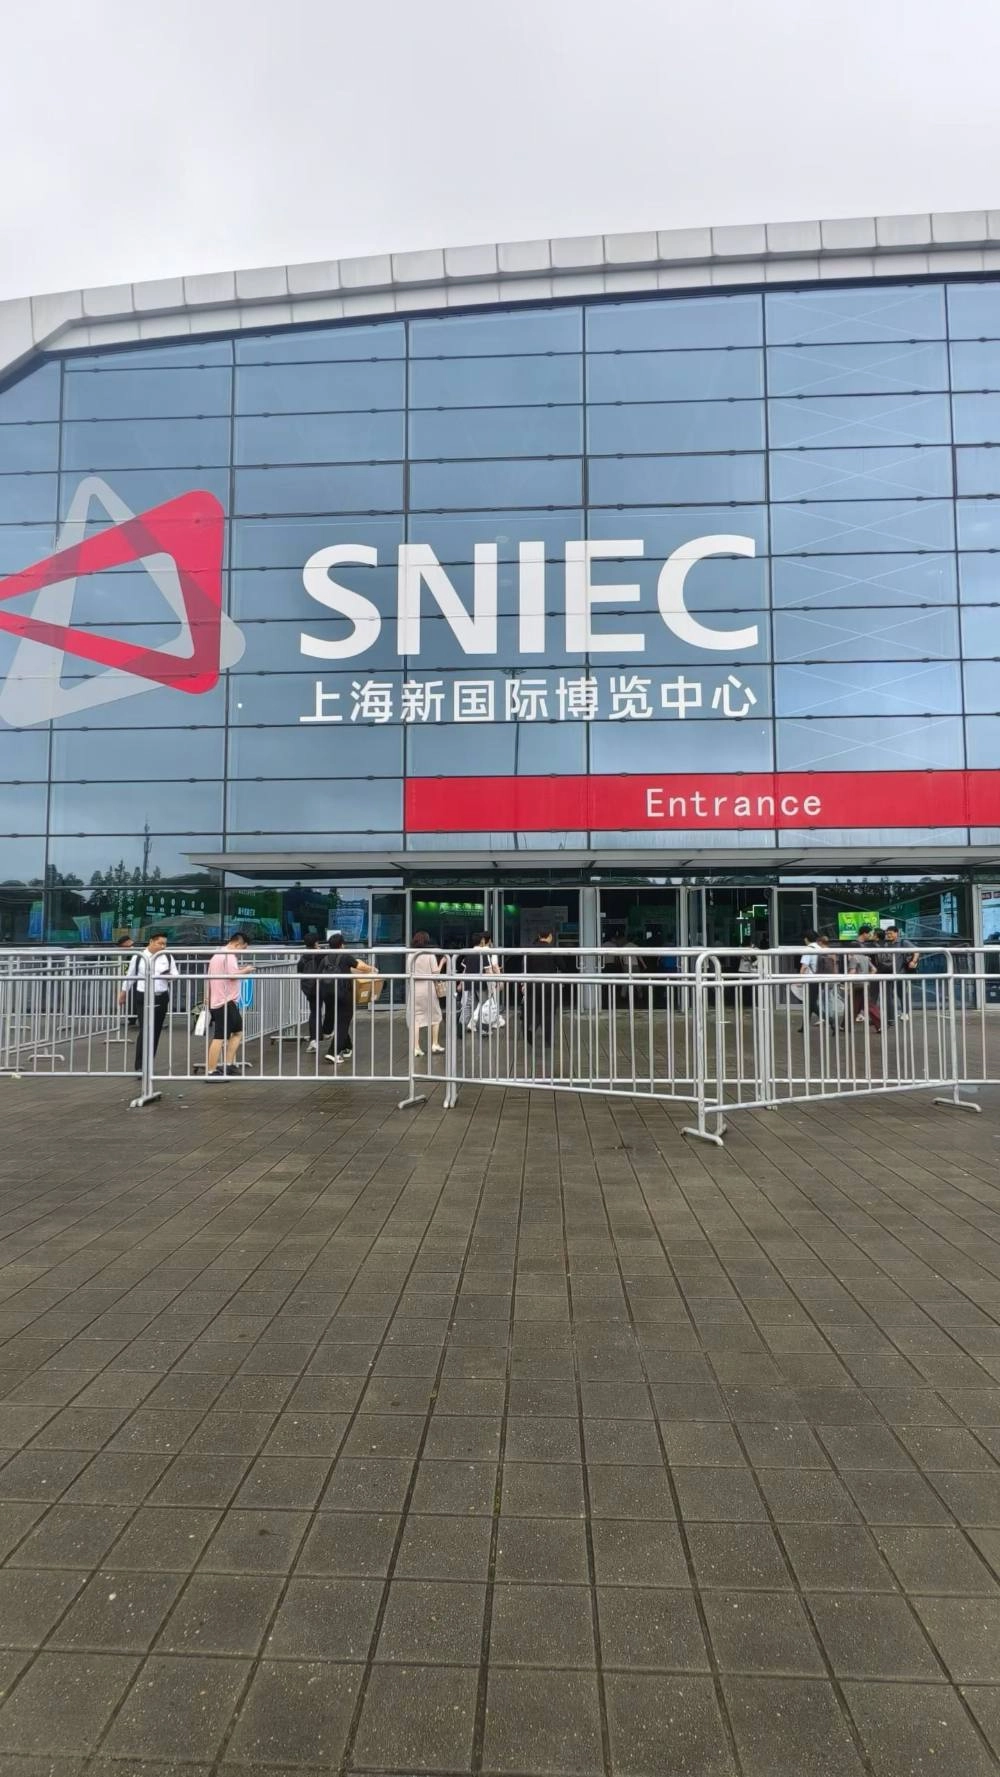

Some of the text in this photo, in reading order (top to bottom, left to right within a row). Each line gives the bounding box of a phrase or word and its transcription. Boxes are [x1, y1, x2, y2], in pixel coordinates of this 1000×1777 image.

[300, 534, 759, 660] SNIEC
[299, 675, 758, 723] 上海新国际博览中心
[646, 788, 822, 817] Entrance
